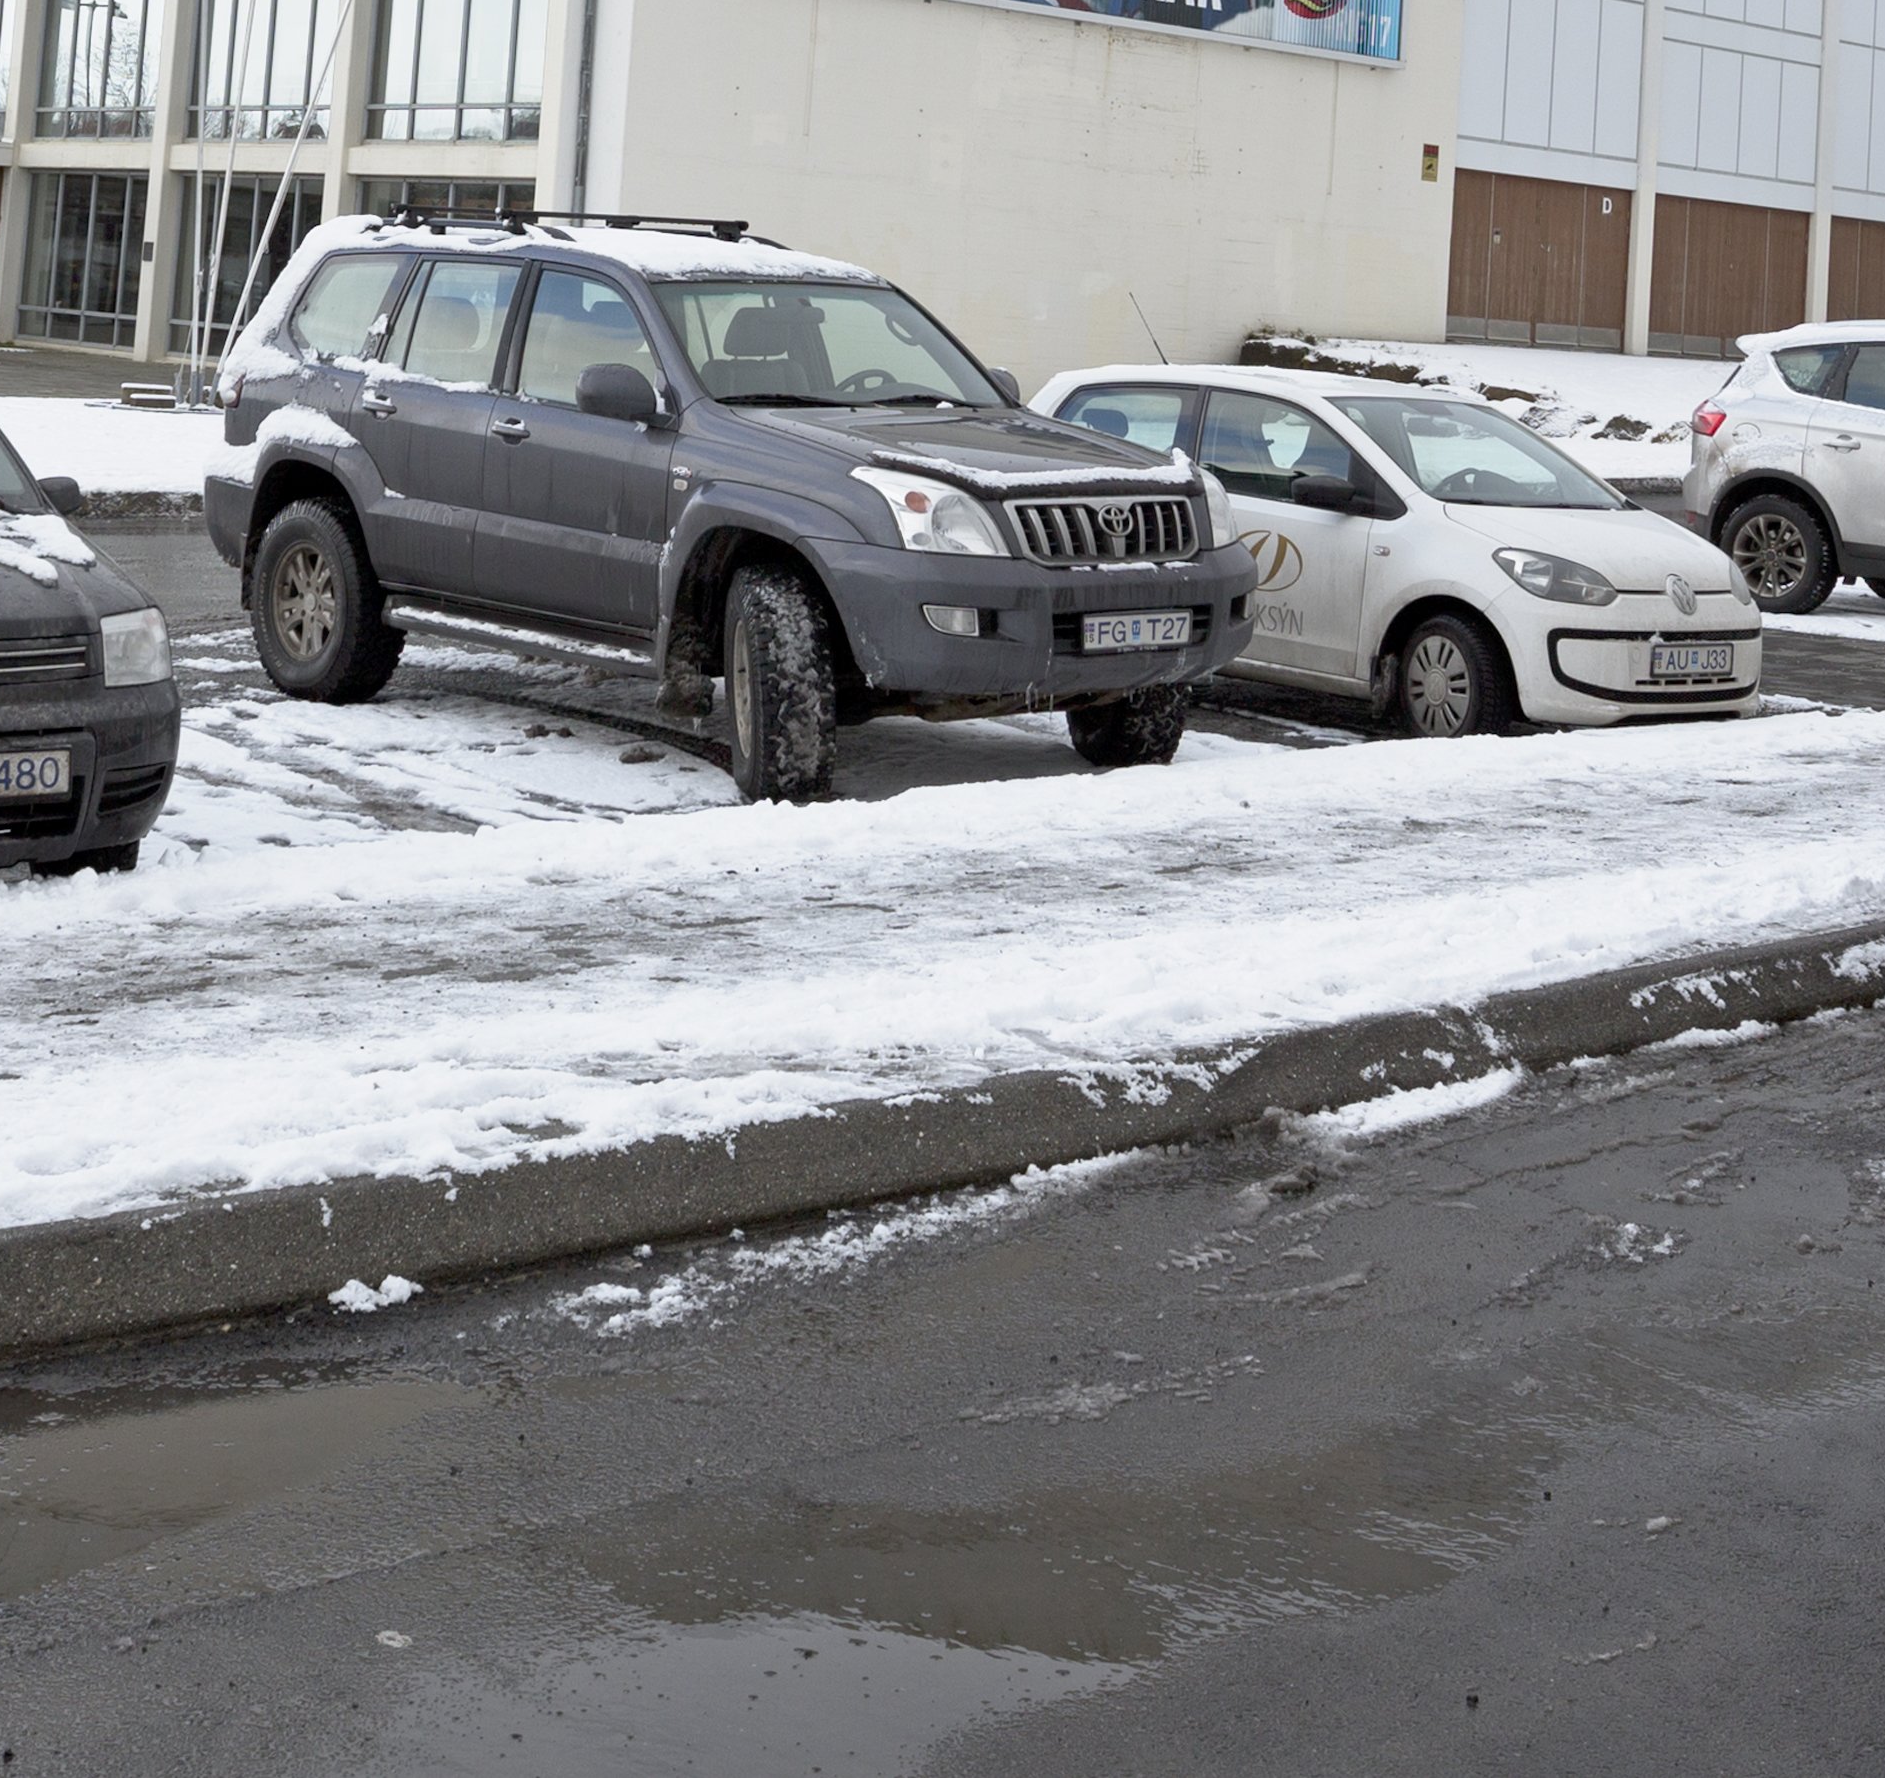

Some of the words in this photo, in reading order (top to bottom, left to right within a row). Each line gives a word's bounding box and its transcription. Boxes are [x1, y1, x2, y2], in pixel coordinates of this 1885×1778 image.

[1602, 197, 1613, 214] D
[1098, 620, 1127, 644] FG
[1147, 617, 1188, 641] T27
[1256, 602, 1304, 637] KSÝN
[1666, 650, 1690, 670] AU
[1701, 649, 1727, 669] J33
